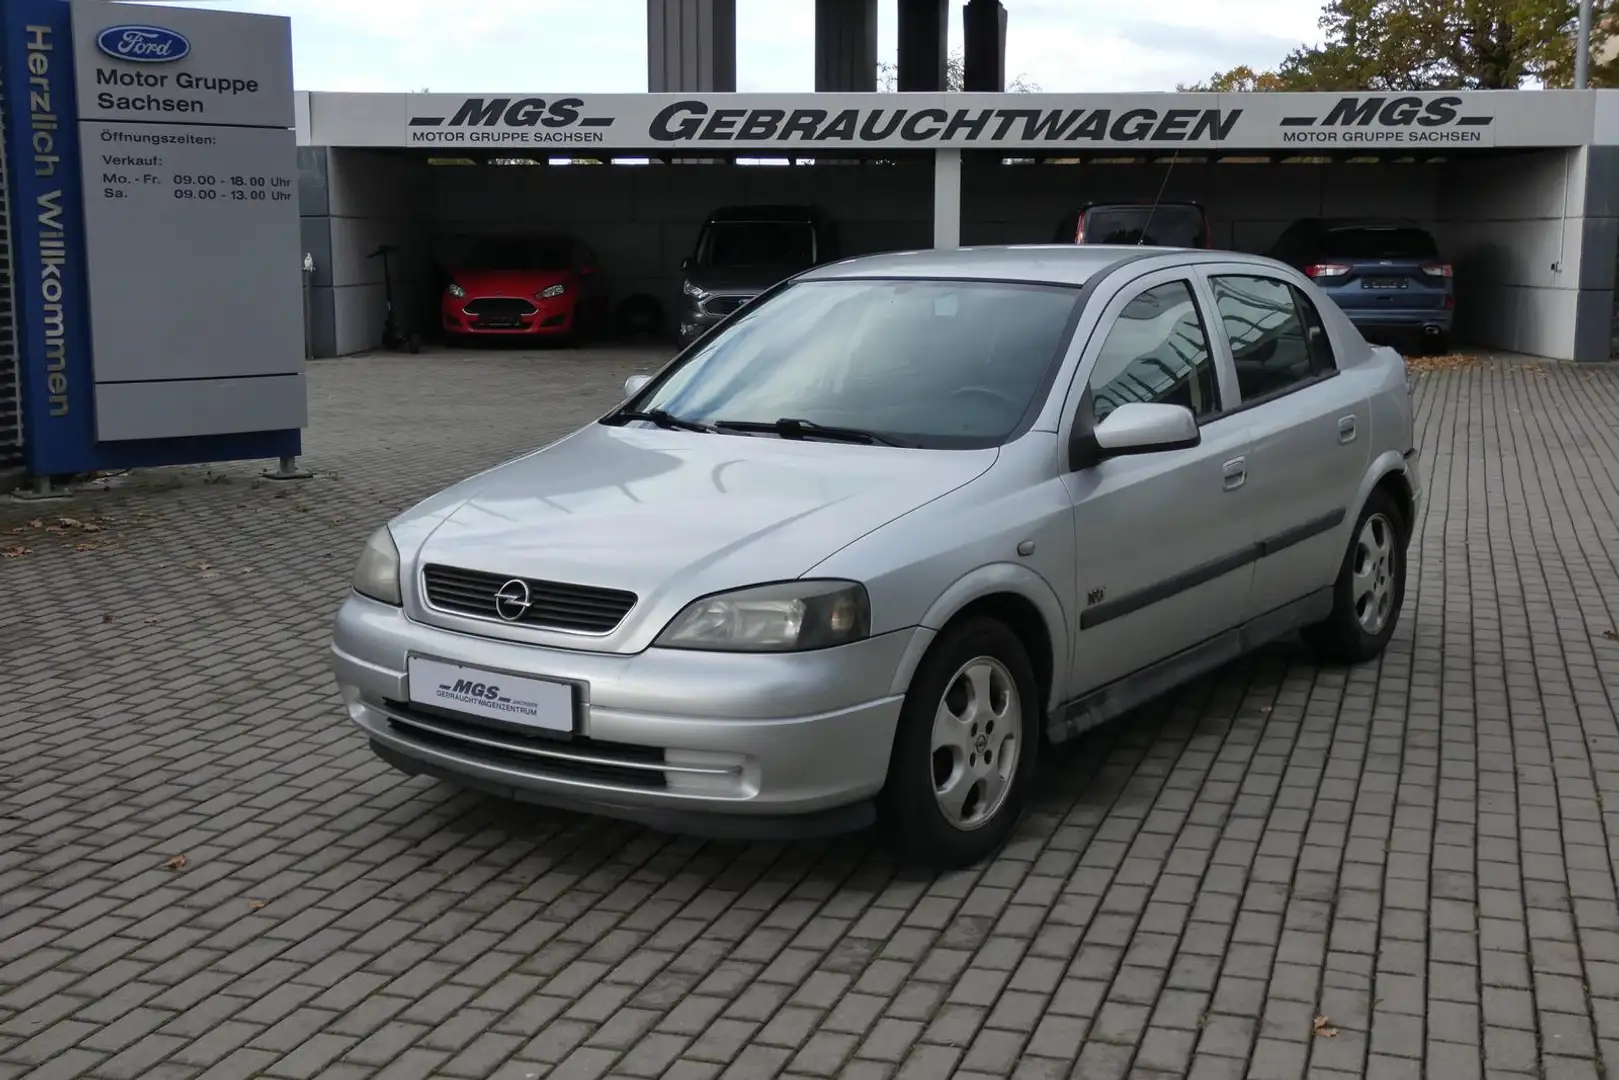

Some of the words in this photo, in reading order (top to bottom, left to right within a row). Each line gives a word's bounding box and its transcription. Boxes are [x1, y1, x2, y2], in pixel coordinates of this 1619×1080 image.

[117, 31, 173, 56] Ford
[96, 68, 167, 88] Motor
[176, 72, 259, 94] Gruppe
[26, 25, 60, 176] Herzlich
[97, 92, 204, 113] Sachsen
[648, 100, 1243, 141] GEBRAUCHTWAGEN
[100, 130, 216, 146] Öffnungszeiten:
[413, 132, 465, 142] MOTOR
[469, 132, 529, 143] GRUPPE
[533, 132, 603, 142] SACHSEN
[1283, 132, 1337, 142] MOTOR
[1342, 131, 1404, 142] GRUPPE
[1408, 131, 1481, 142] SACHSEN
[102, 154, 163, 167] Verkauf:
[143, 174, 161, 185] Fr.
[173, 175, 216, 186] 09.00
[230, 176, 265, 187] 18.00
[271, 177, 291, 188] Uhr
[104, 188, 128, 199] Sa.
[174, 189, 217, 200] 09.00
[230, 190, 266, 200] 13.00
[271, 191, 292, 201] Uhr
[37, 190, 69, 417] Willkommen
[453, 679, 500, 700] MGS
[436, 690, 537, 716] GEBRAUCHTWAGENZENTRUM
